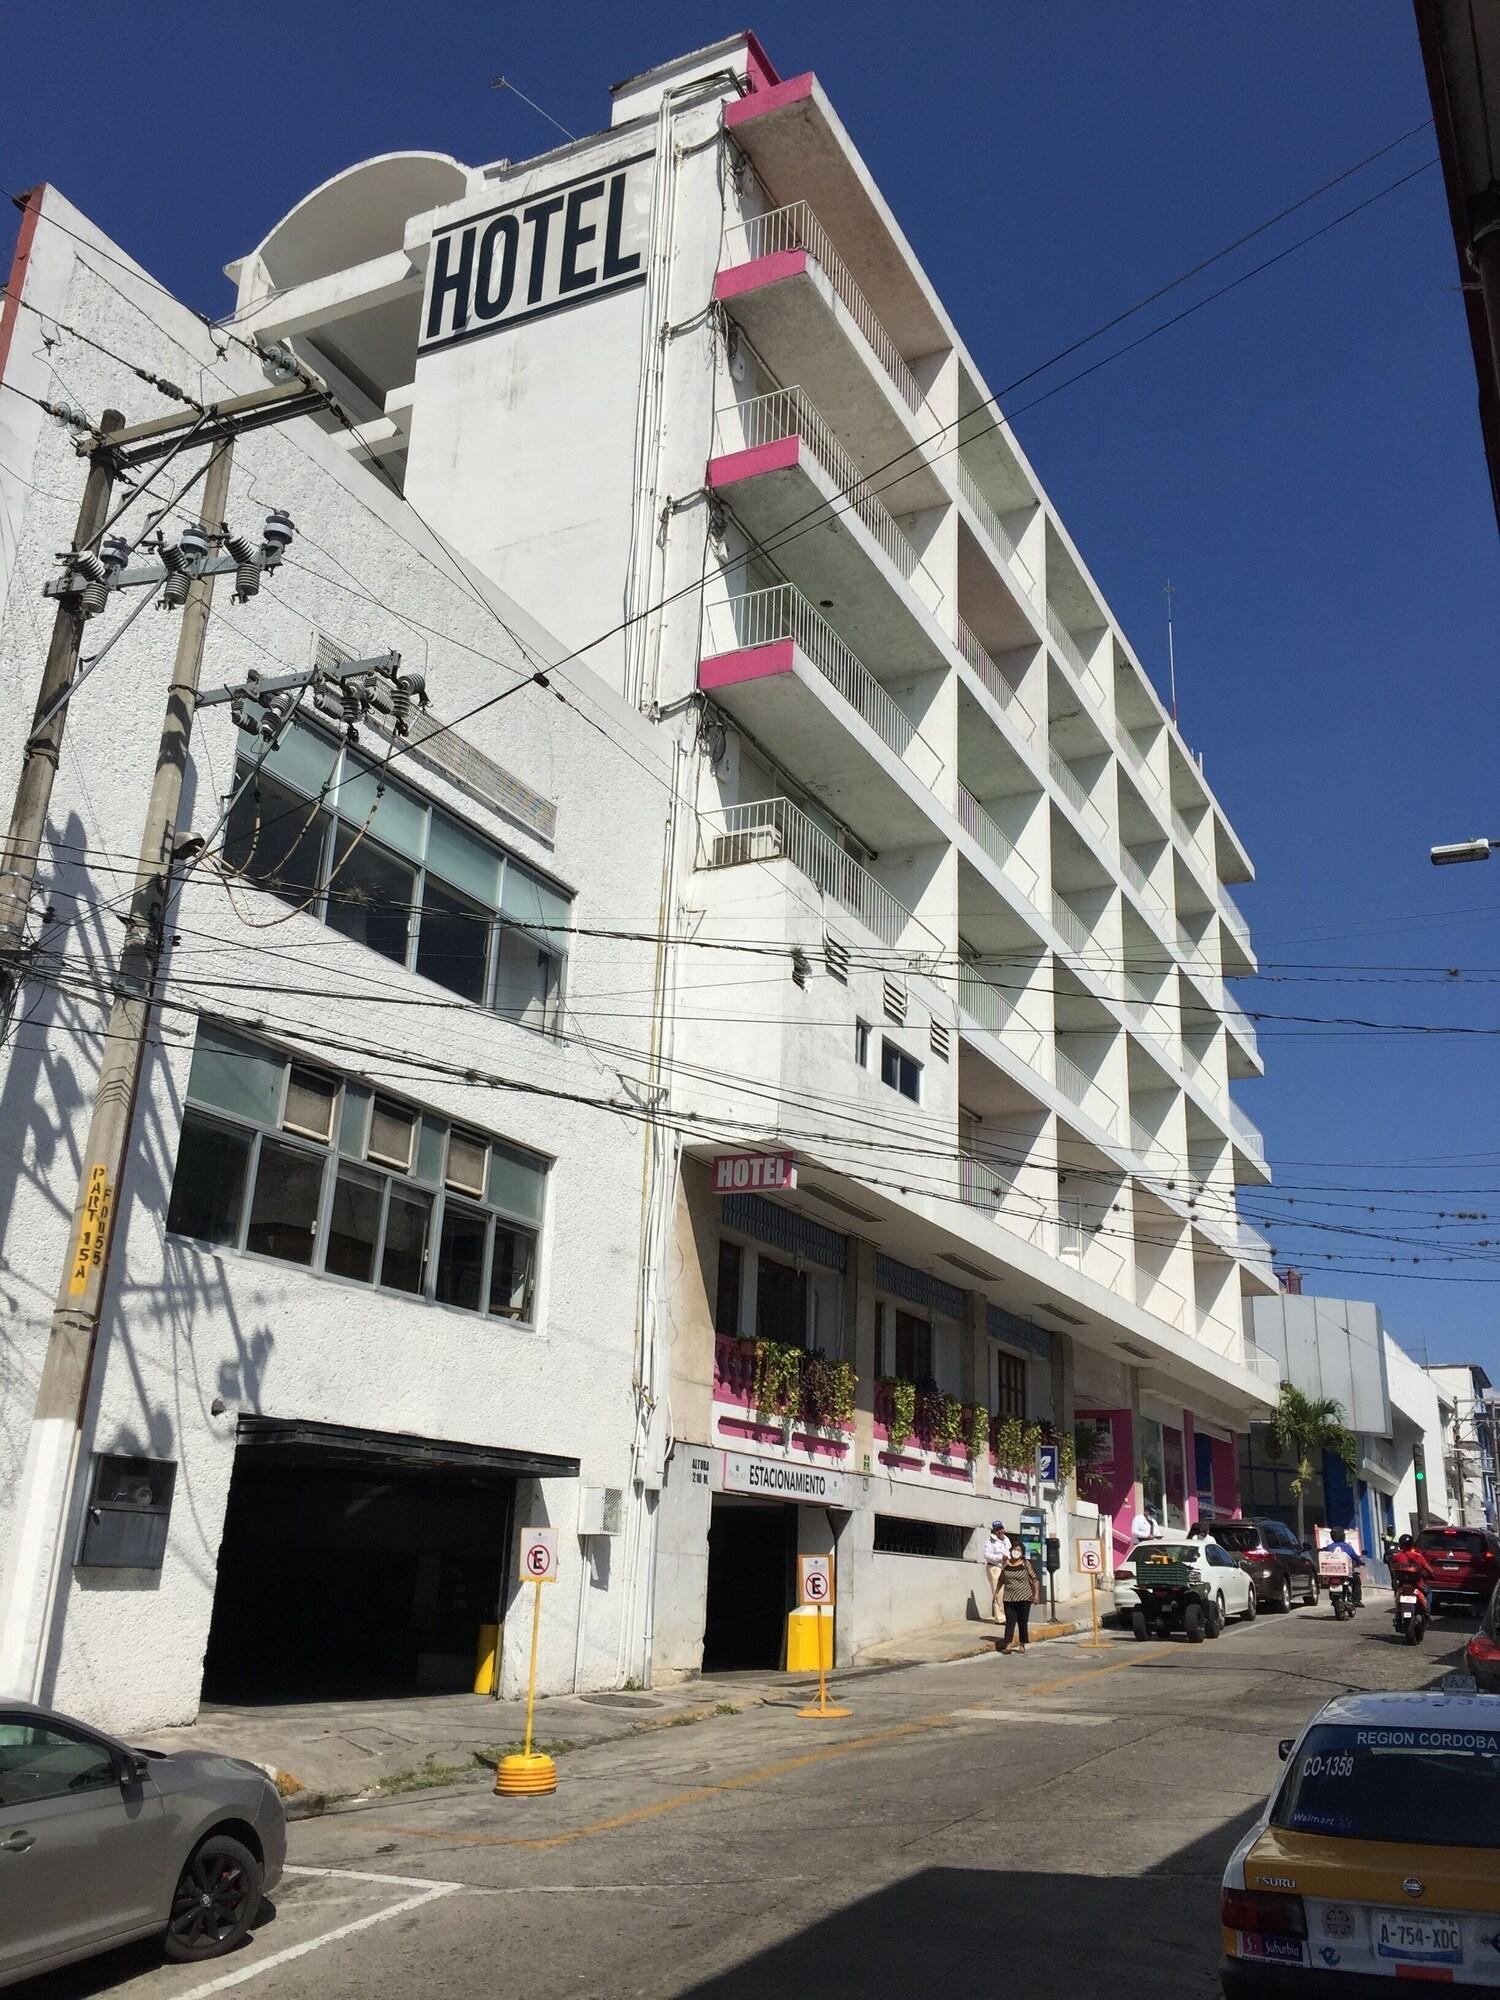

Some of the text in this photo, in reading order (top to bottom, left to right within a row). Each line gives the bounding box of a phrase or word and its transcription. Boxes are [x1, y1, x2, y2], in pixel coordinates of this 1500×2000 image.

[426, 172, 641, 339] HOTEL
[717, 1157, 787, 1188] HOTEL
[88, 1168, 105, 1222] PART
[692, 1458, 710, 1471] ALTURA
[749, 1464, 826, 1496] ESTACIONAMIENTO
[533, 1550, 544, 1569] E
[1087, 1554, 1096, 1567] E
[812, 1577, 822, 1594] E
[1357, 1731, 1498, 1750] REGION CORDOBA
[1303, 1756, 1354, 1777] CO-1358
[1294, 1812, 1335, 1825] Walmart
[1255, 1876, 1297, 1888] TSURU
[1381, 1923, 1459, 1950] A-754-XDC
[1265, 1940, 1299, 1956] Suburbia
